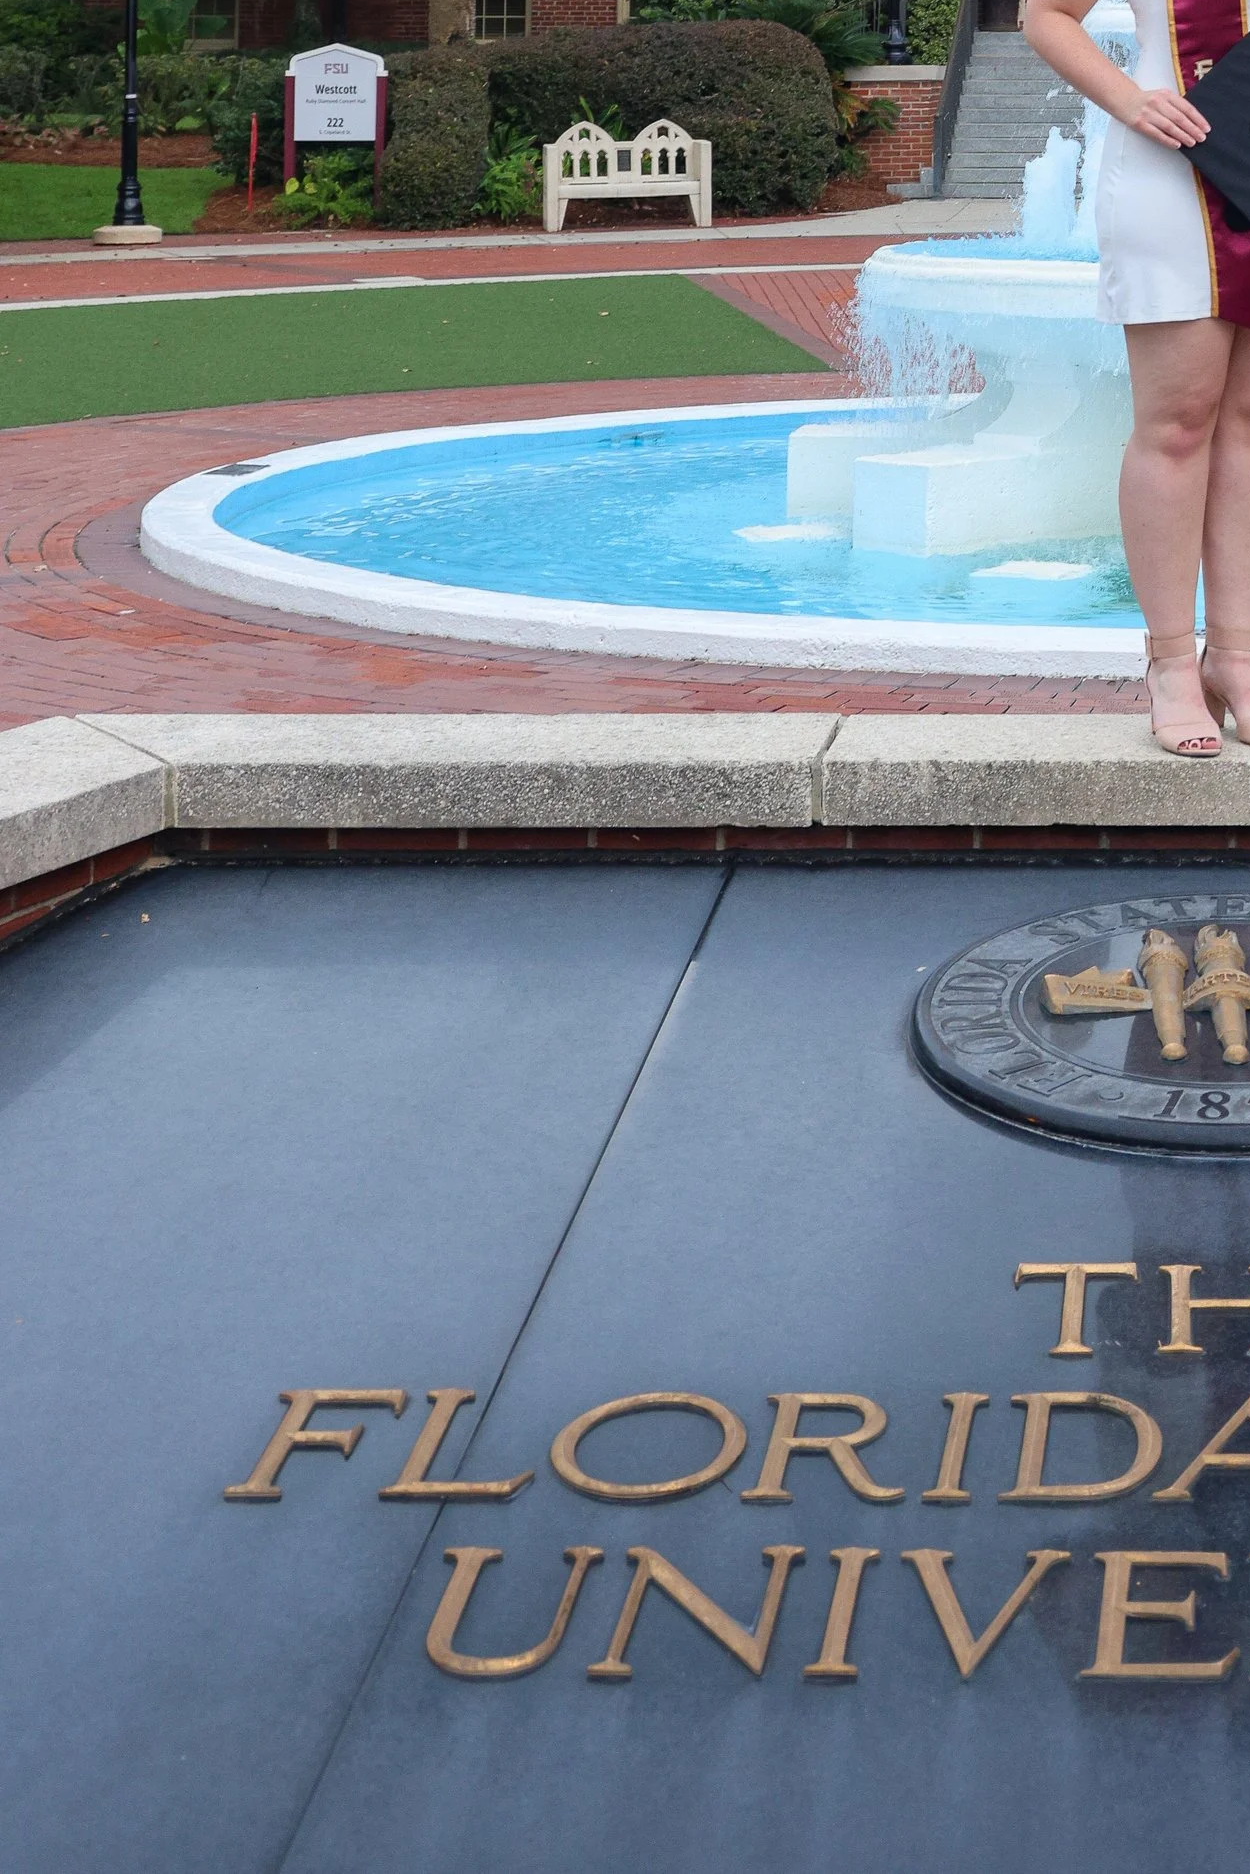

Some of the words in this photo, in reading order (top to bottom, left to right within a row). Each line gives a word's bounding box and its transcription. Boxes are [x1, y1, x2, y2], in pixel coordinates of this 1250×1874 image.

[324, 63, 349, 75] FSU
[315, 84, 357, 95] Westcott
[326, 117, 344, 128] 222
[1064, 981, 1146, 1003] VIRES
[938, 957, 1094, 1098] FLORIDA
